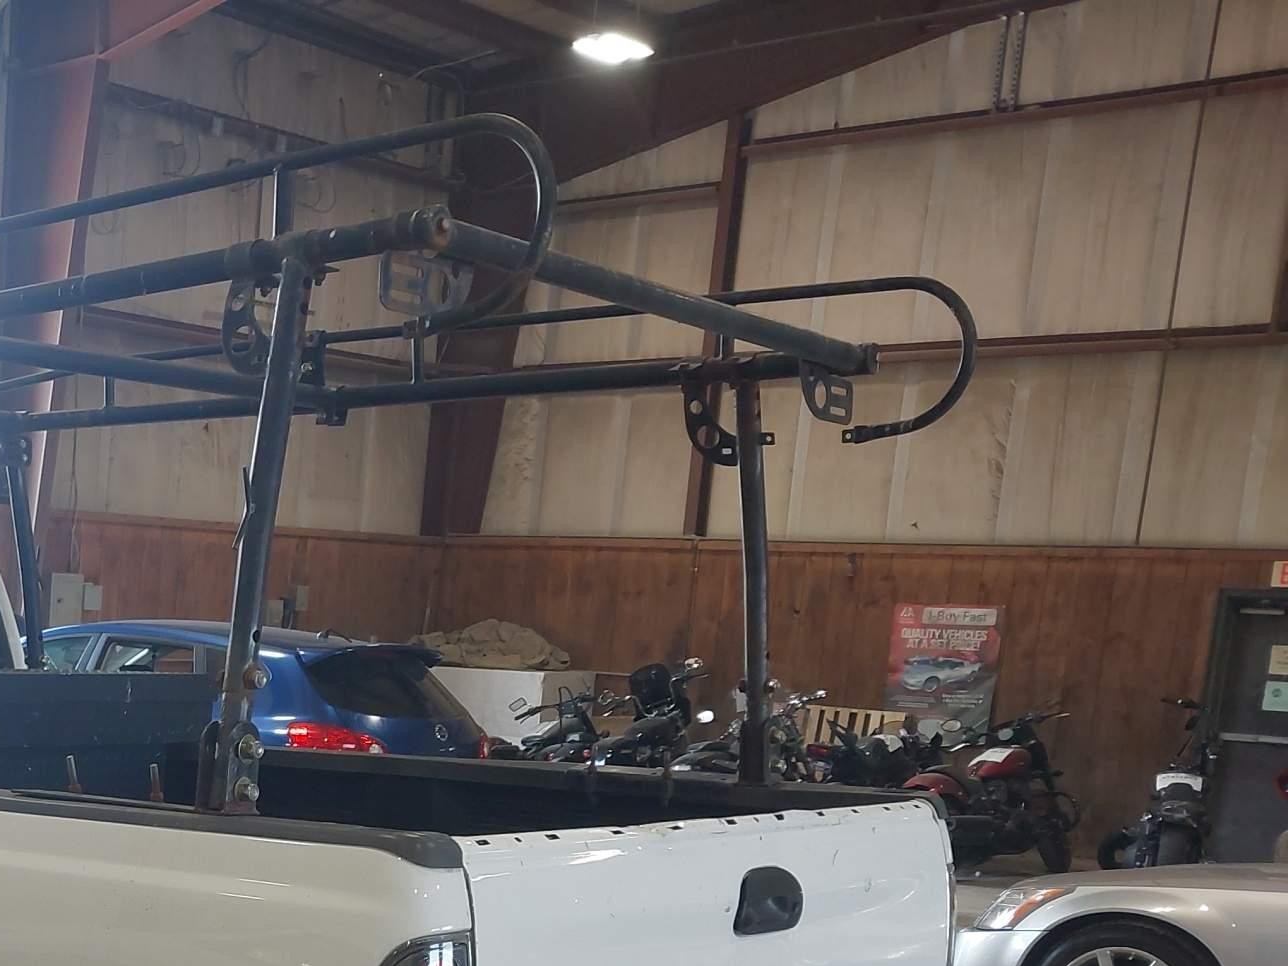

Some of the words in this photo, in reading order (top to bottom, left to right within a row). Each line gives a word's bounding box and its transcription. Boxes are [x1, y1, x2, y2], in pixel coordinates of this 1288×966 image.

[963, 610, 987, 622] Fast
[901, 627, 942, 639] QUALITY
[943, 629, 988, 641] VEHICLES
[906, 639, 919, 649] AT
[930, 640, 948, 649] SET
